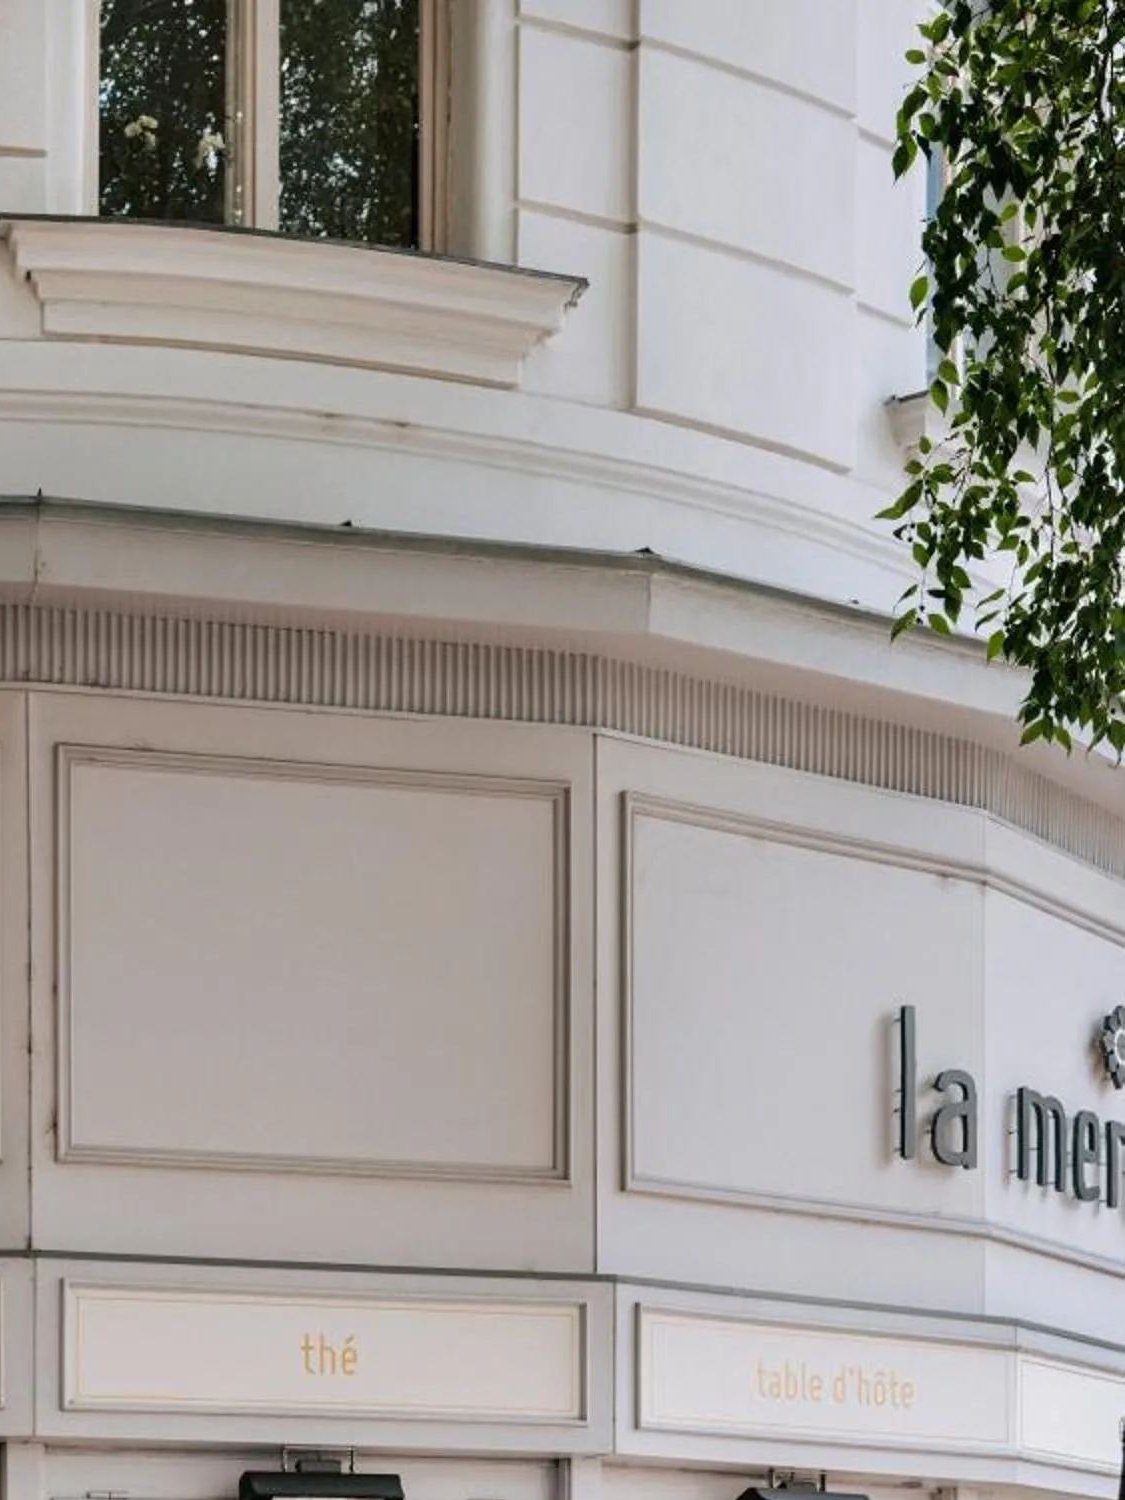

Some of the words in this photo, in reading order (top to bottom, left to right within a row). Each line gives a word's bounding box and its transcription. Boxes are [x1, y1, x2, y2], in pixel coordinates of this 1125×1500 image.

[899, 1005, 978, 1170] la
[300, 1332, 358, 1376] thé
[755, 1358, 823, 1401] table
[833, 1364, 916, 1409] d'hôte
